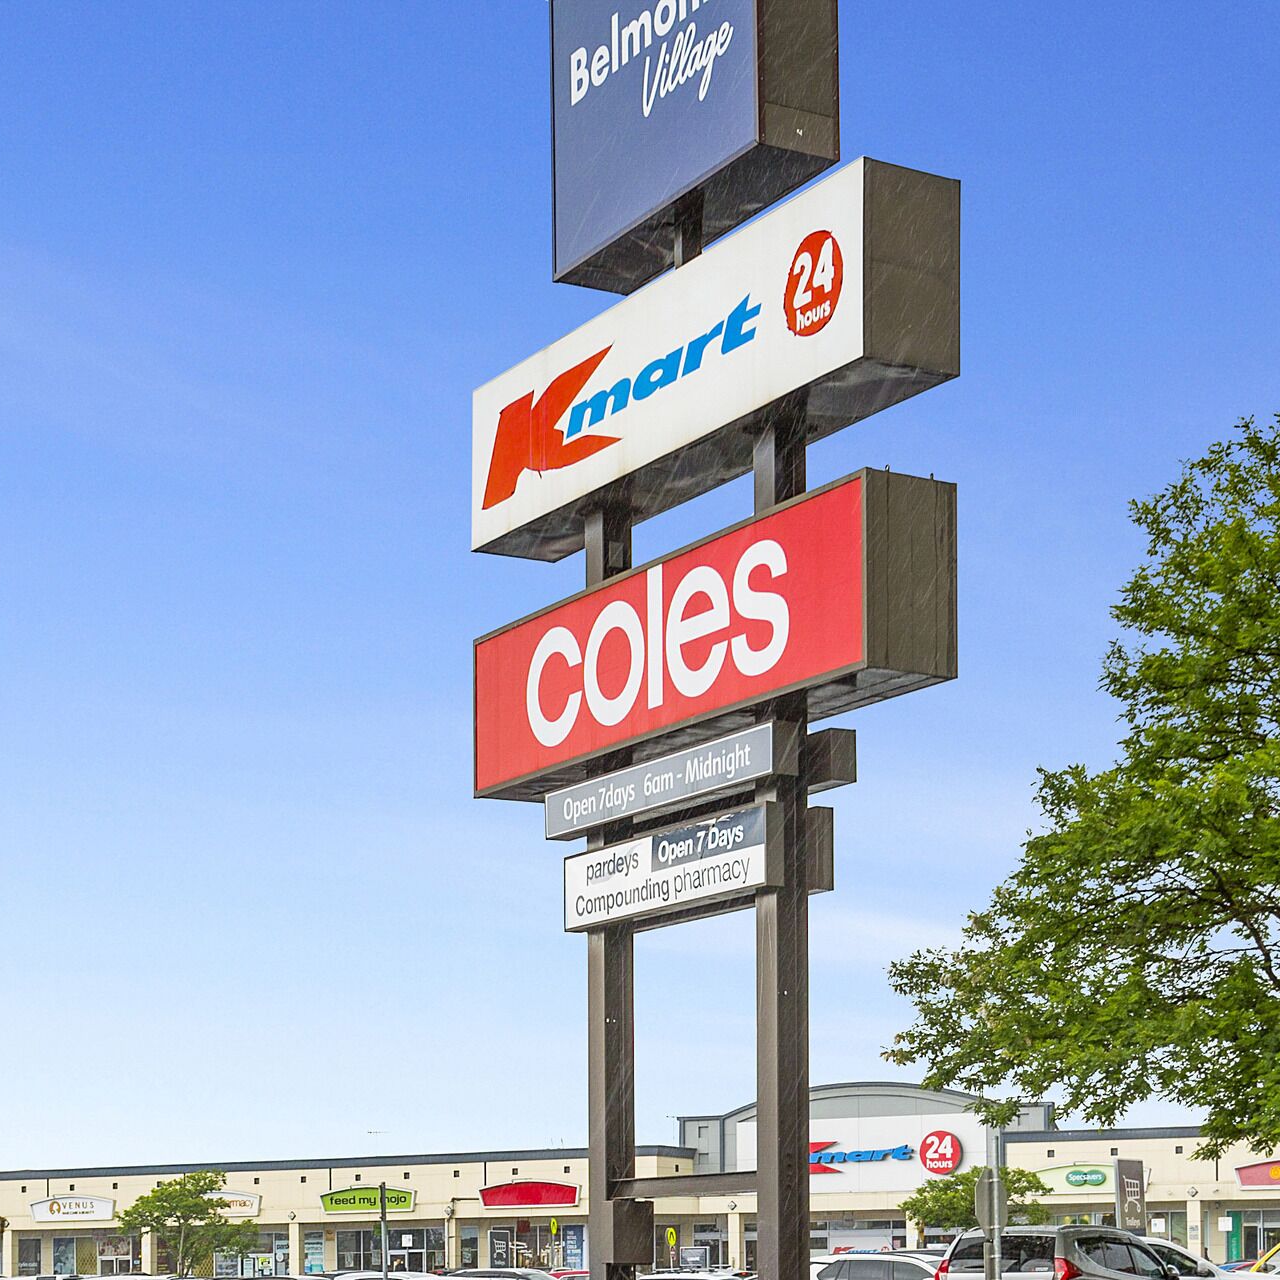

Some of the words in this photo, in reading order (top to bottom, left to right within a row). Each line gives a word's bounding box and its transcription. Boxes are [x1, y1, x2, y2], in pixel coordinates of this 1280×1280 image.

[570, 0, 709, 106] Belmo
[642, 21, 734, 117] Village
[792, 236, 837, 308] 24
[795, 298, 832, 333] hours
[482, 293, 761, 510] Kmart
[526, 539, 790, 748] coles
[563, 793, 597, 823] Open
[598, 783, 635, 811] 7days
[643, 773, 674, 796] 6am
[685, 744, 751, 784] Midnight
[586, 852, 639, 886] pardeys
[658, 839, 693, 864] Open
[696, 832, 705, 848] 7
[708, 824, 744, 849] Days
[575, 878, 670, 916] Compounding
[674, 857, 751, 899] pharmacy
[925, 1135, 953, 1159] 24
[926, 1158, 953, 1169] hours
[62, 1201, 95, 1209] VENUS
[330, 1195, 356, 1205] feed
[358, 1196, 377, 1206] my
[1068, 1172, 1103, 1183] Specsavers
